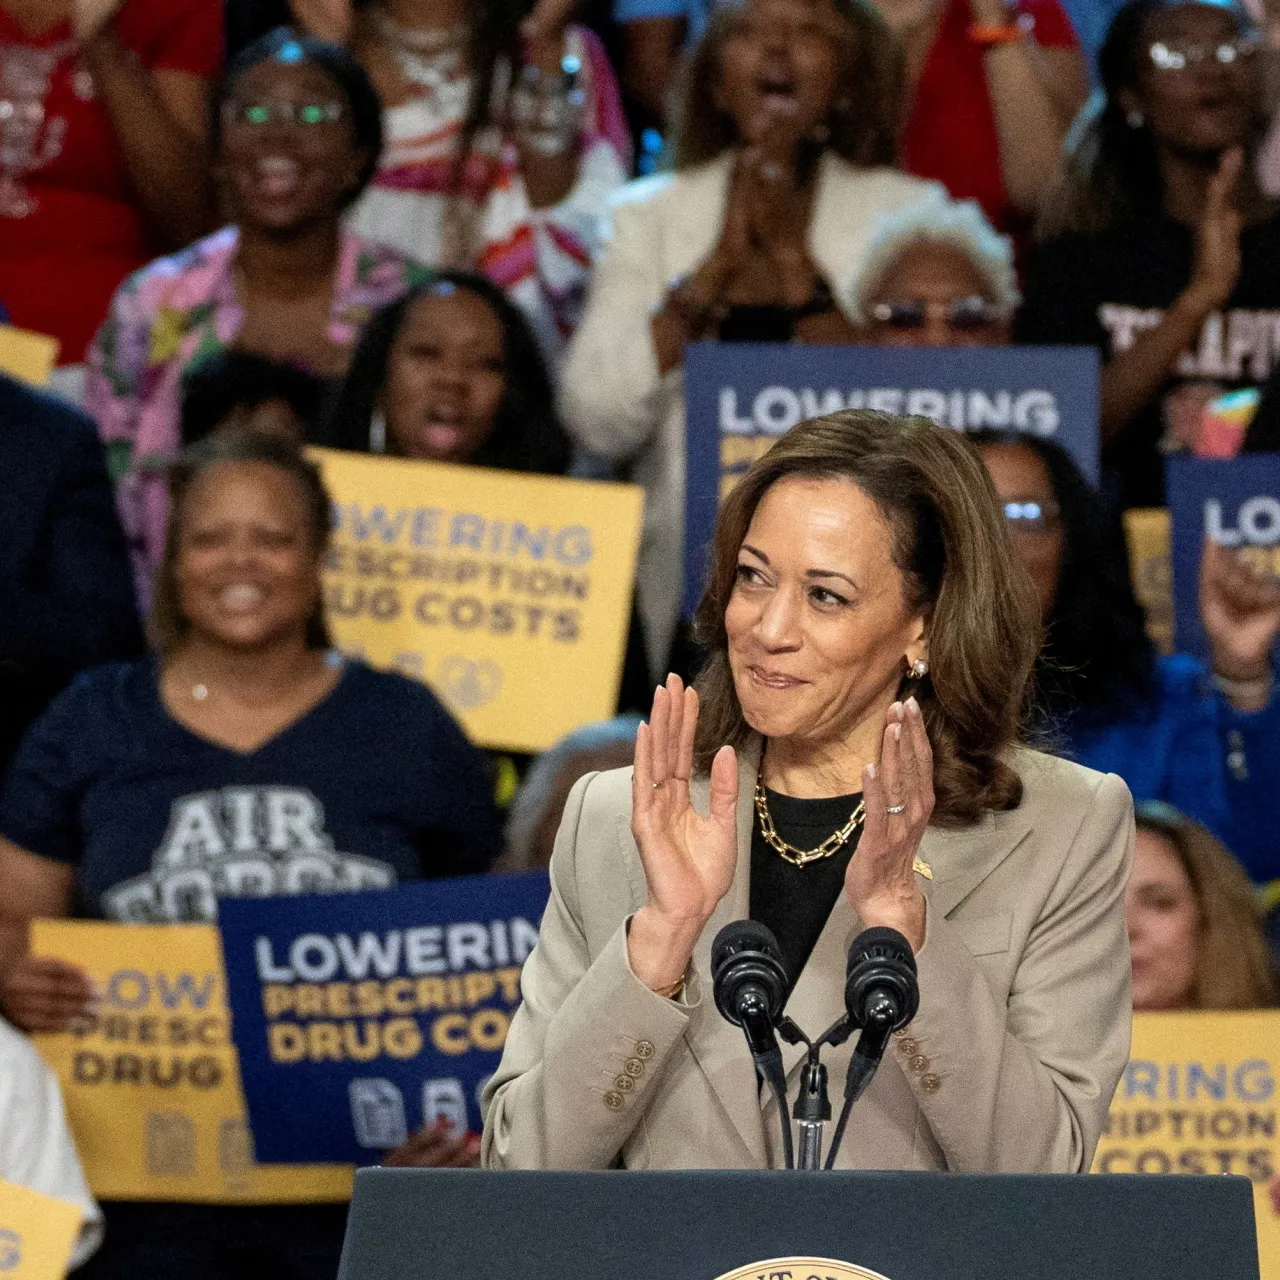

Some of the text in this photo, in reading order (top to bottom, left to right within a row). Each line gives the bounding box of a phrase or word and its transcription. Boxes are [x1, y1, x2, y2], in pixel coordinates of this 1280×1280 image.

[331, 503, 594, 568] WERING
[414, 590, 584, 643] COSTS
[168, 783, 325, 868] AIR
[254, 915, 542, 984] LOWERI
[261, 967, 523, 1019] PRESCRIPT
[268, 1017, 424, 1064] DRUG
[71, 1048, 224, 1090] DRUG
[1120, 1059, 1276, 1104] RING
